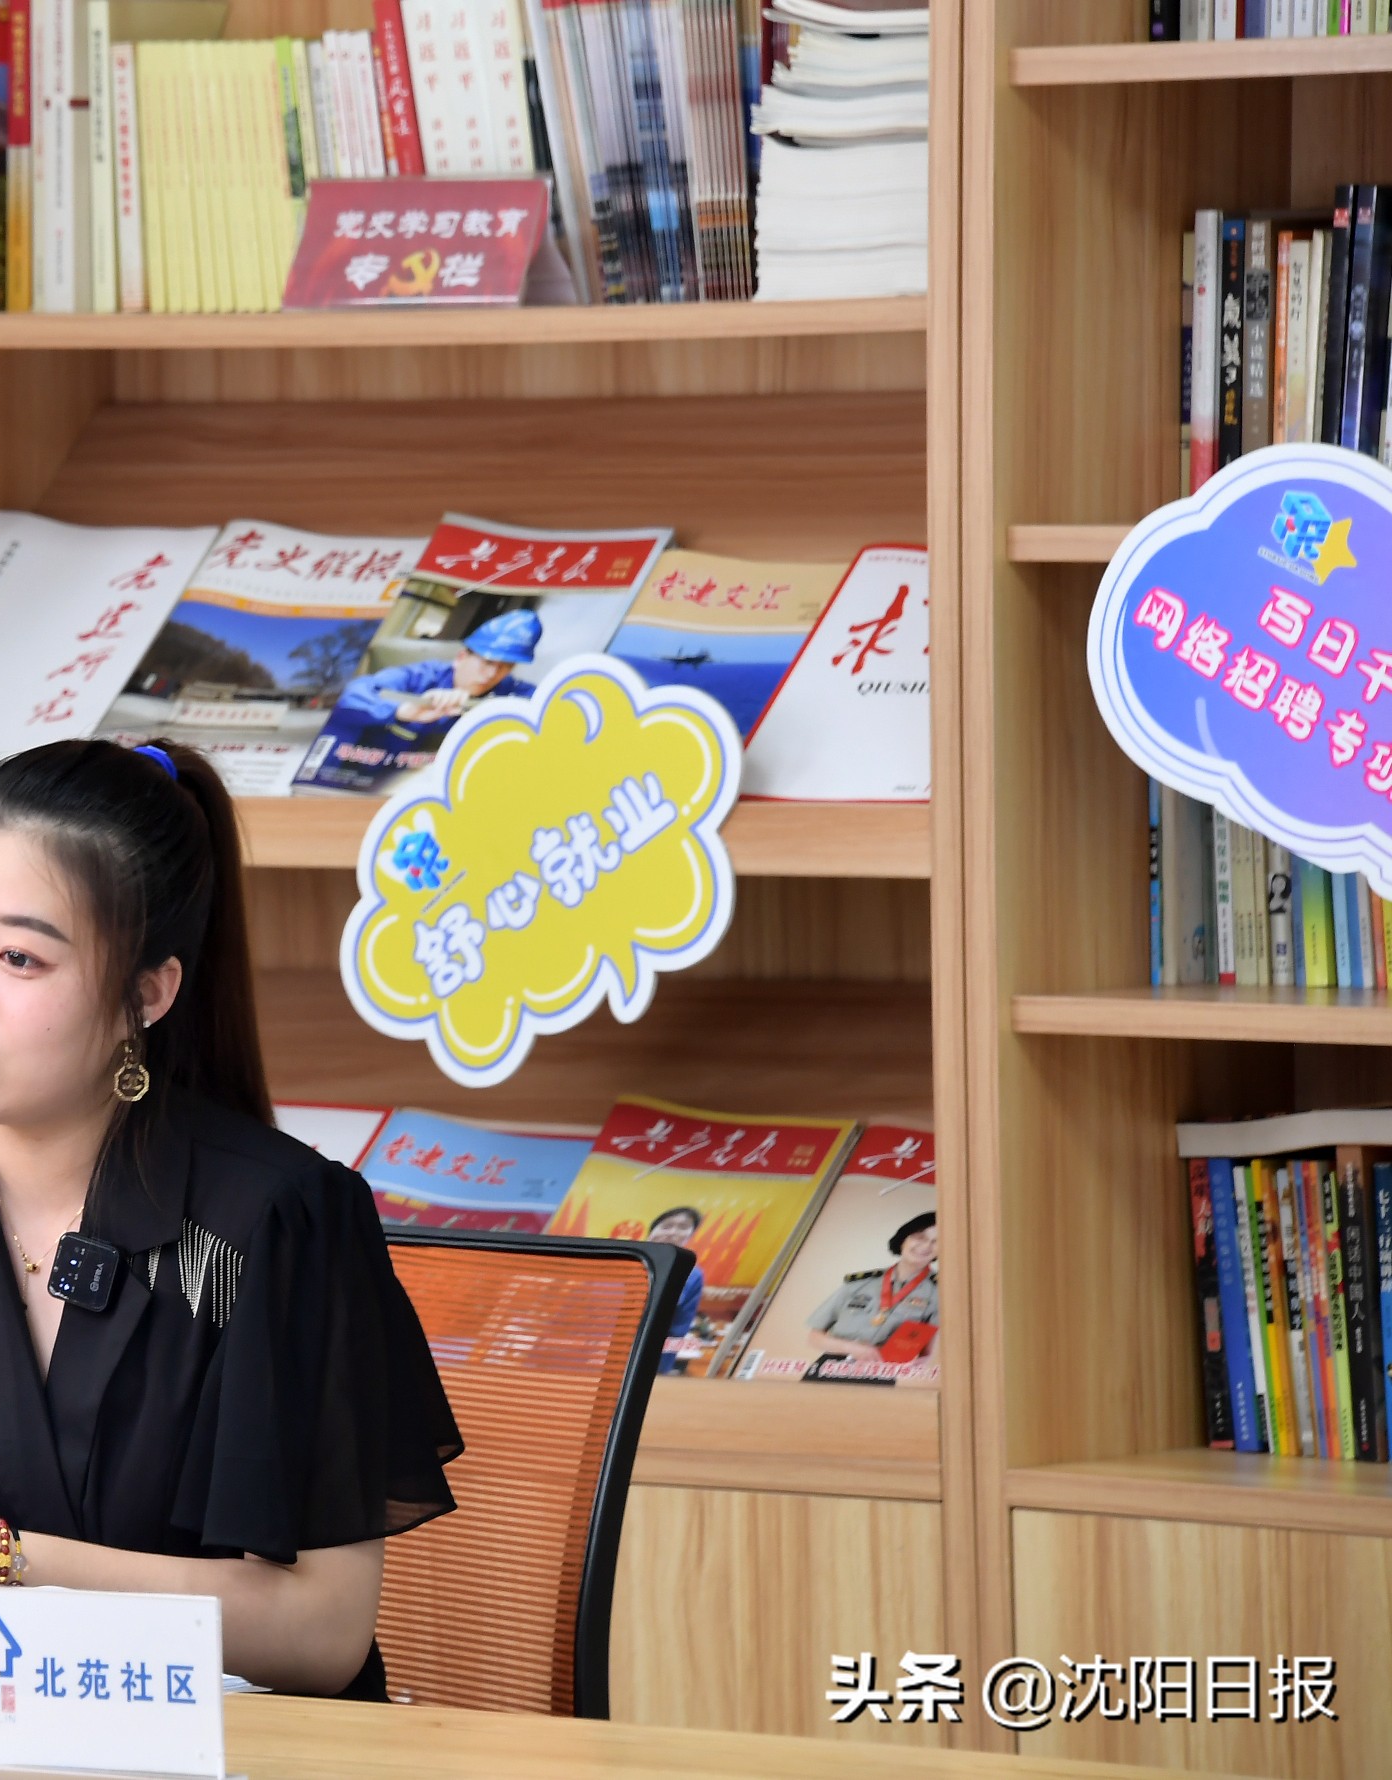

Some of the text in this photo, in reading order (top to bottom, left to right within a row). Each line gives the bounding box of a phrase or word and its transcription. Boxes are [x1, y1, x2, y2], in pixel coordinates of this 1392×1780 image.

[333, 207, 528, 241] 党史学习教育
[656, 569, 791, 612] 党建文汇
[831, 584, 929, 675] 求
[413, 772, 678, 999] 舒心就业
[381, 1131, 518, 1186] 党建文汇
[34, 1660, 197, 1705] 北苑社区
